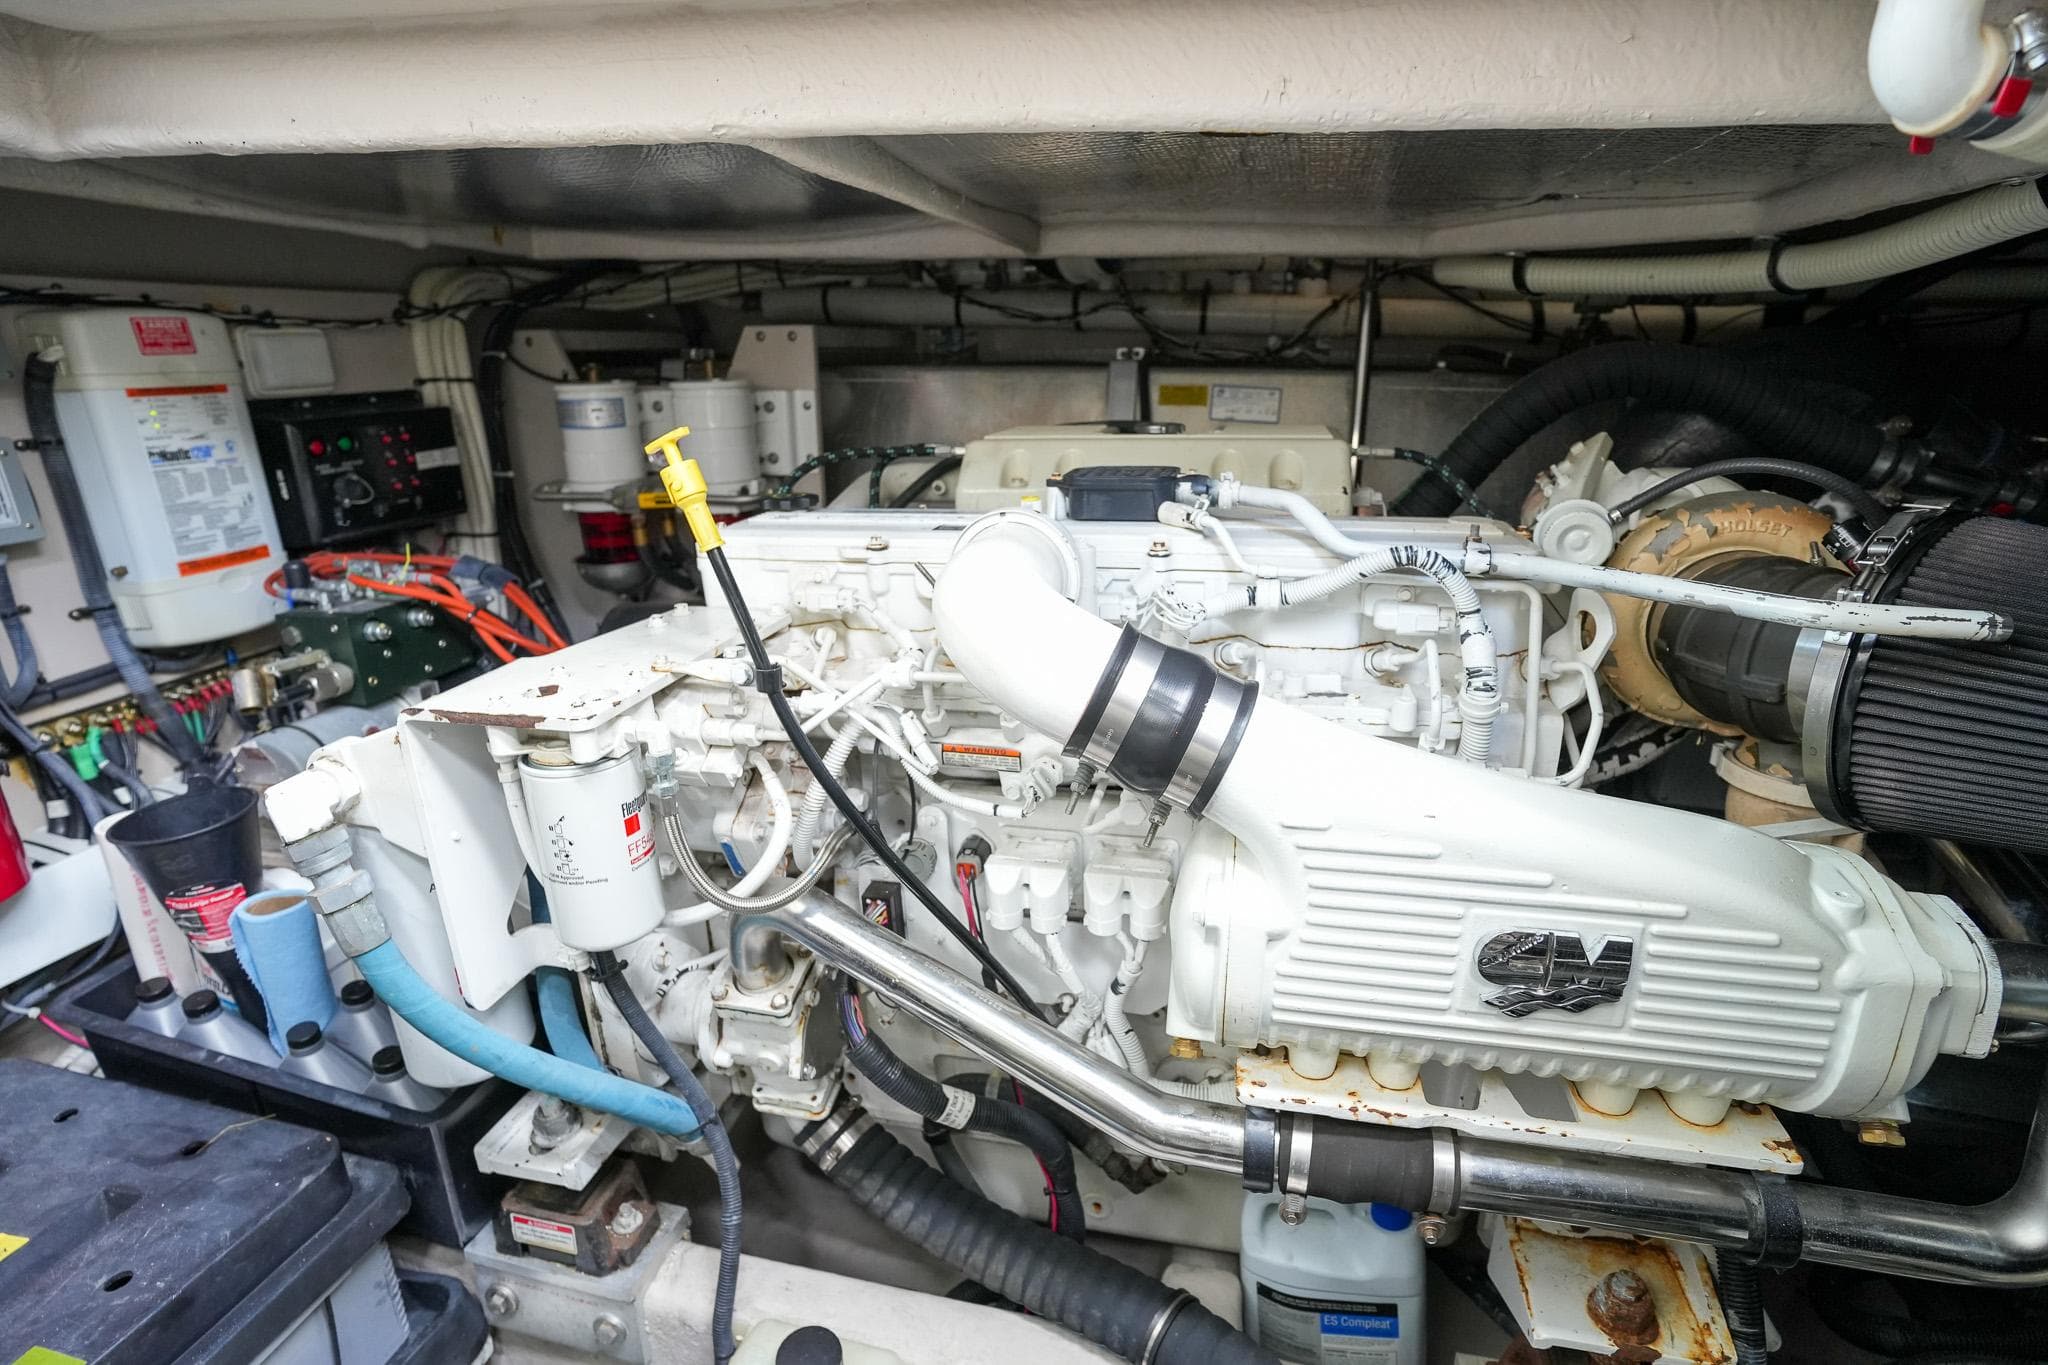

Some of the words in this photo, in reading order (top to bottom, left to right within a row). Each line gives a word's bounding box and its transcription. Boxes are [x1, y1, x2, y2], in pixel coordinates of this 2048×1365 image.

[1719, 518, 1793, 538] HOLSET
[963, 746, 1007, 755] WARNING
[1323, 1315, 1339, 1326] ES
[1340, 1315, 1392, 1330] Compleat
